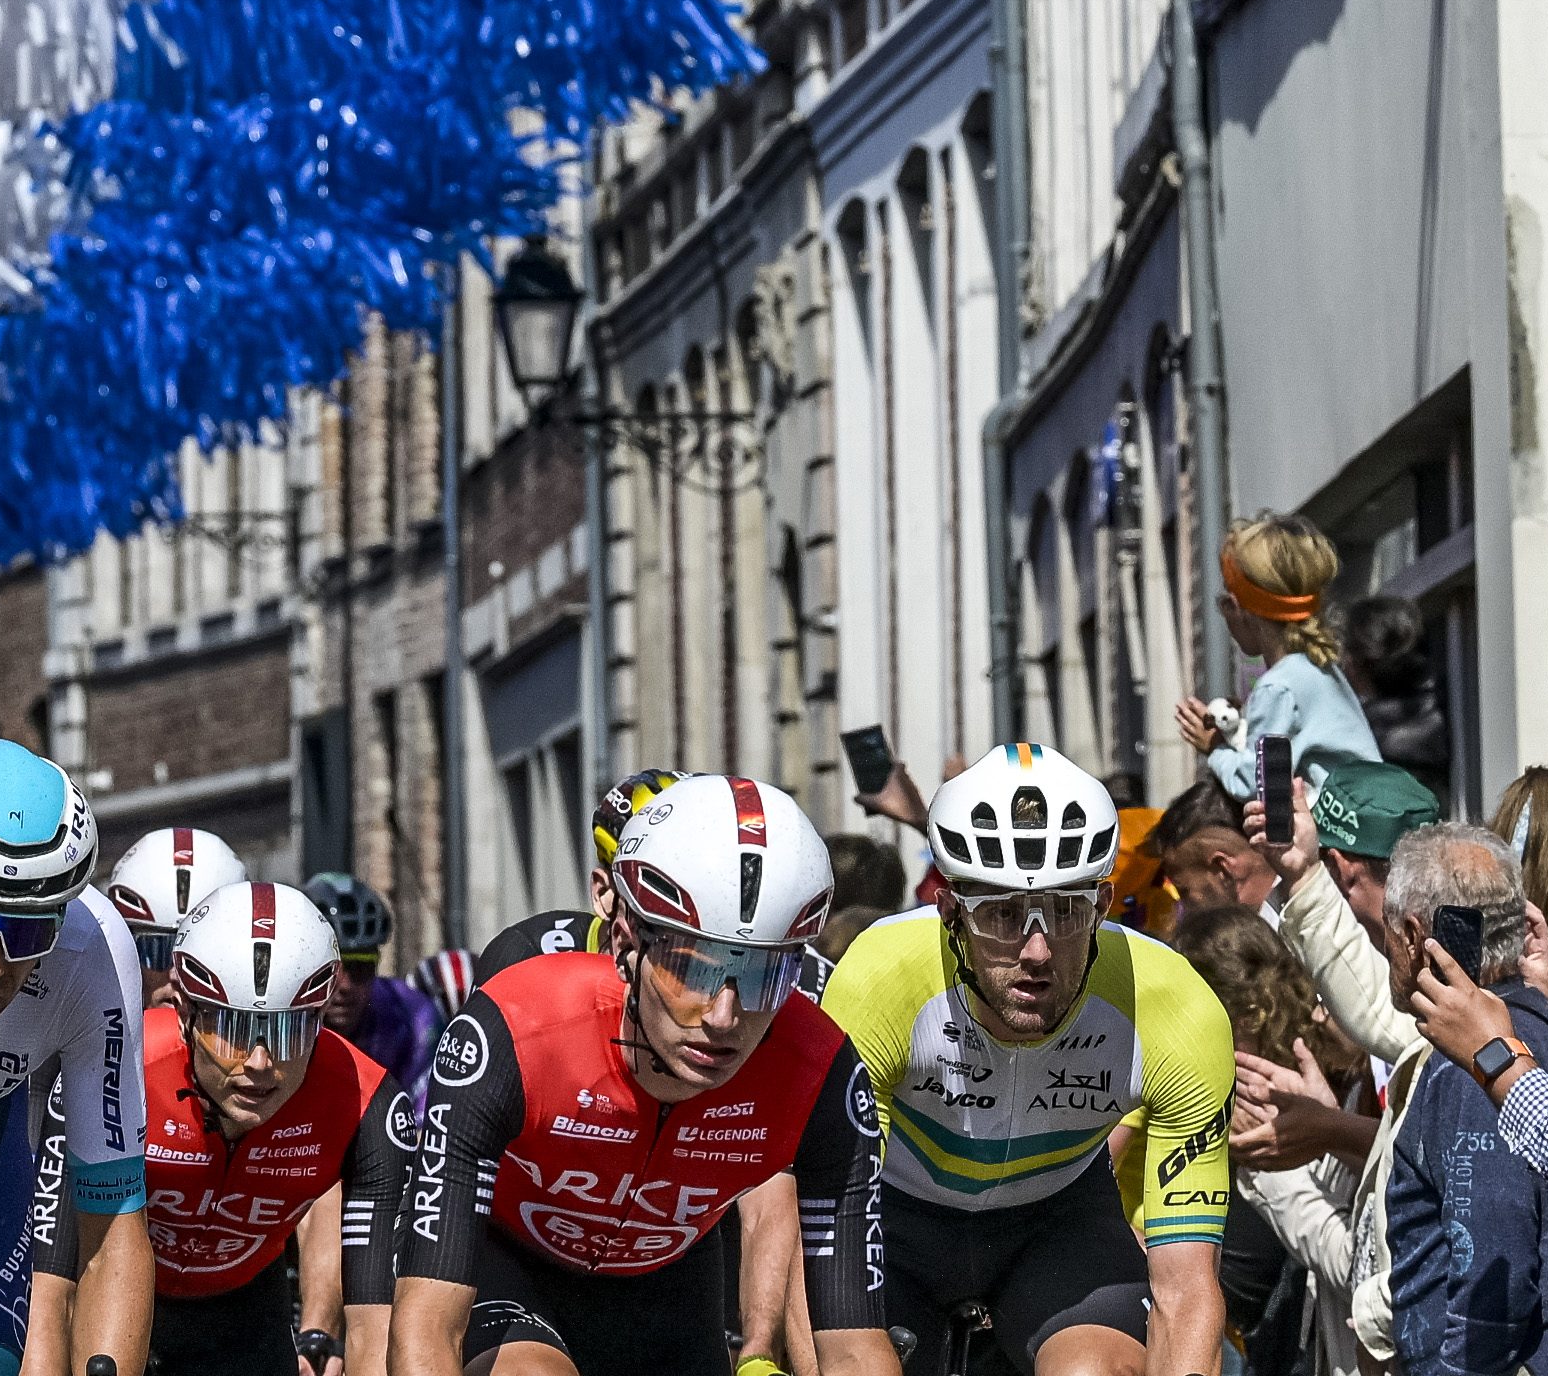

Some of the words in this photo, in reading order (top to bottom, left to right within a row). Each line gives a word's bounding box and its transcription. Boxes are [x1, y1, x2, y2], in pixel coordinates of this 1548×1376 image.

[104, 1007, 126, 1153] MERIDA
[913, 1076, 996, 1110] Jayco
[1026, 1091, 1124, 1115] ALULA
[552, 1114, 640, 1141] Bianchi
[699, 1127, 768, 1142] LEGENDRE
[145, 1143, 212, 1163] Bianchi
[267, 1144, 321, 1159] LEGENDRE
[673, 1148, 764, 1164] SAMSIC
[245, 1166, 318, 1178] SAMSIC
[412, 1102, 452, 1243] ARKEA
[33, 1134, 67, 1244] ARKEA
[504, 1149, 750, 1224] ARKE
[1162, 1190, 1230, 1207] CAD
[865, 1154, 884, 1292] ARKEA
